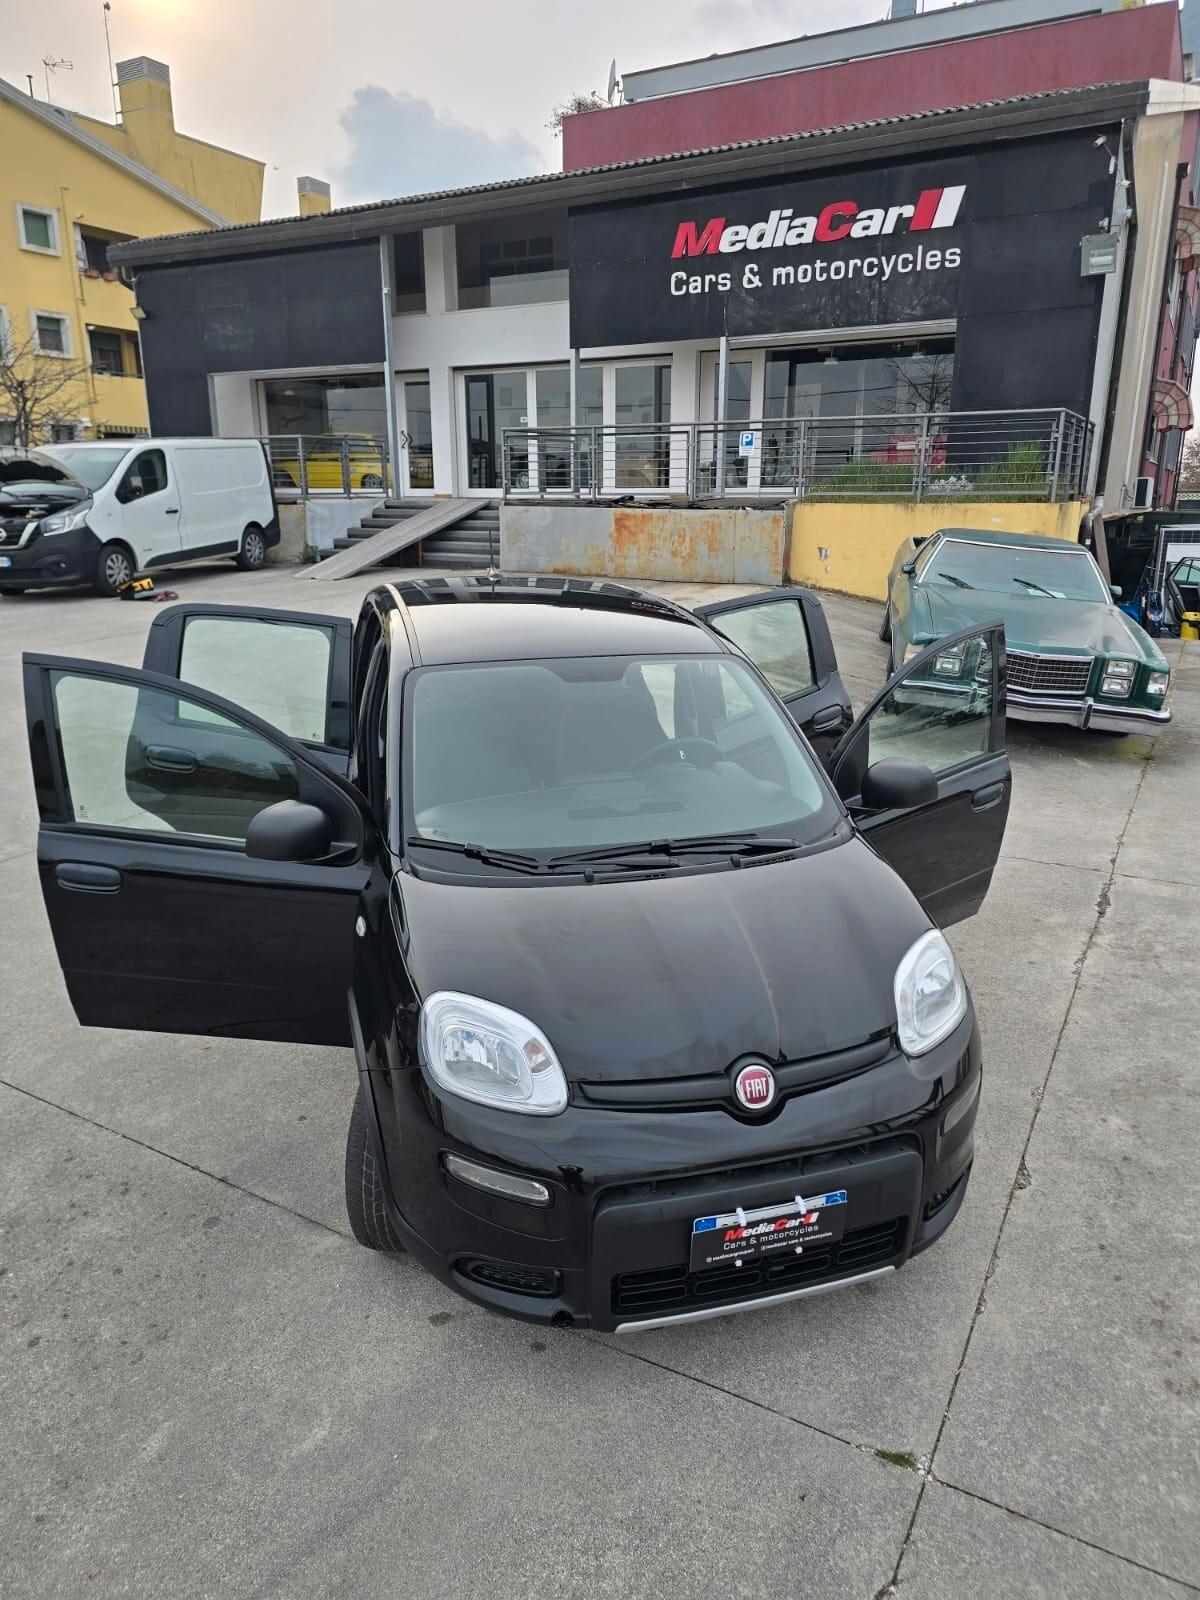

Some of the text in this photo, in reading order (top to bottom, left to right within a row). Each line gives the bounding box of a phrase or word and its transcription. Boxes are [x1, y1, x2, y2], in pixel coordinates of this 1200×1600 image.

[670, 201, 915, 260] MediaCar
[670, 245, 962, 296] Cars & motorcycles
[742, 433, 752, 446] P
[744, 1077, 768, 1100] FIAT
[723, 1225, 820, 1251] Cars & motorcycles
[724, 1217, 804, 1242] MediaCar
